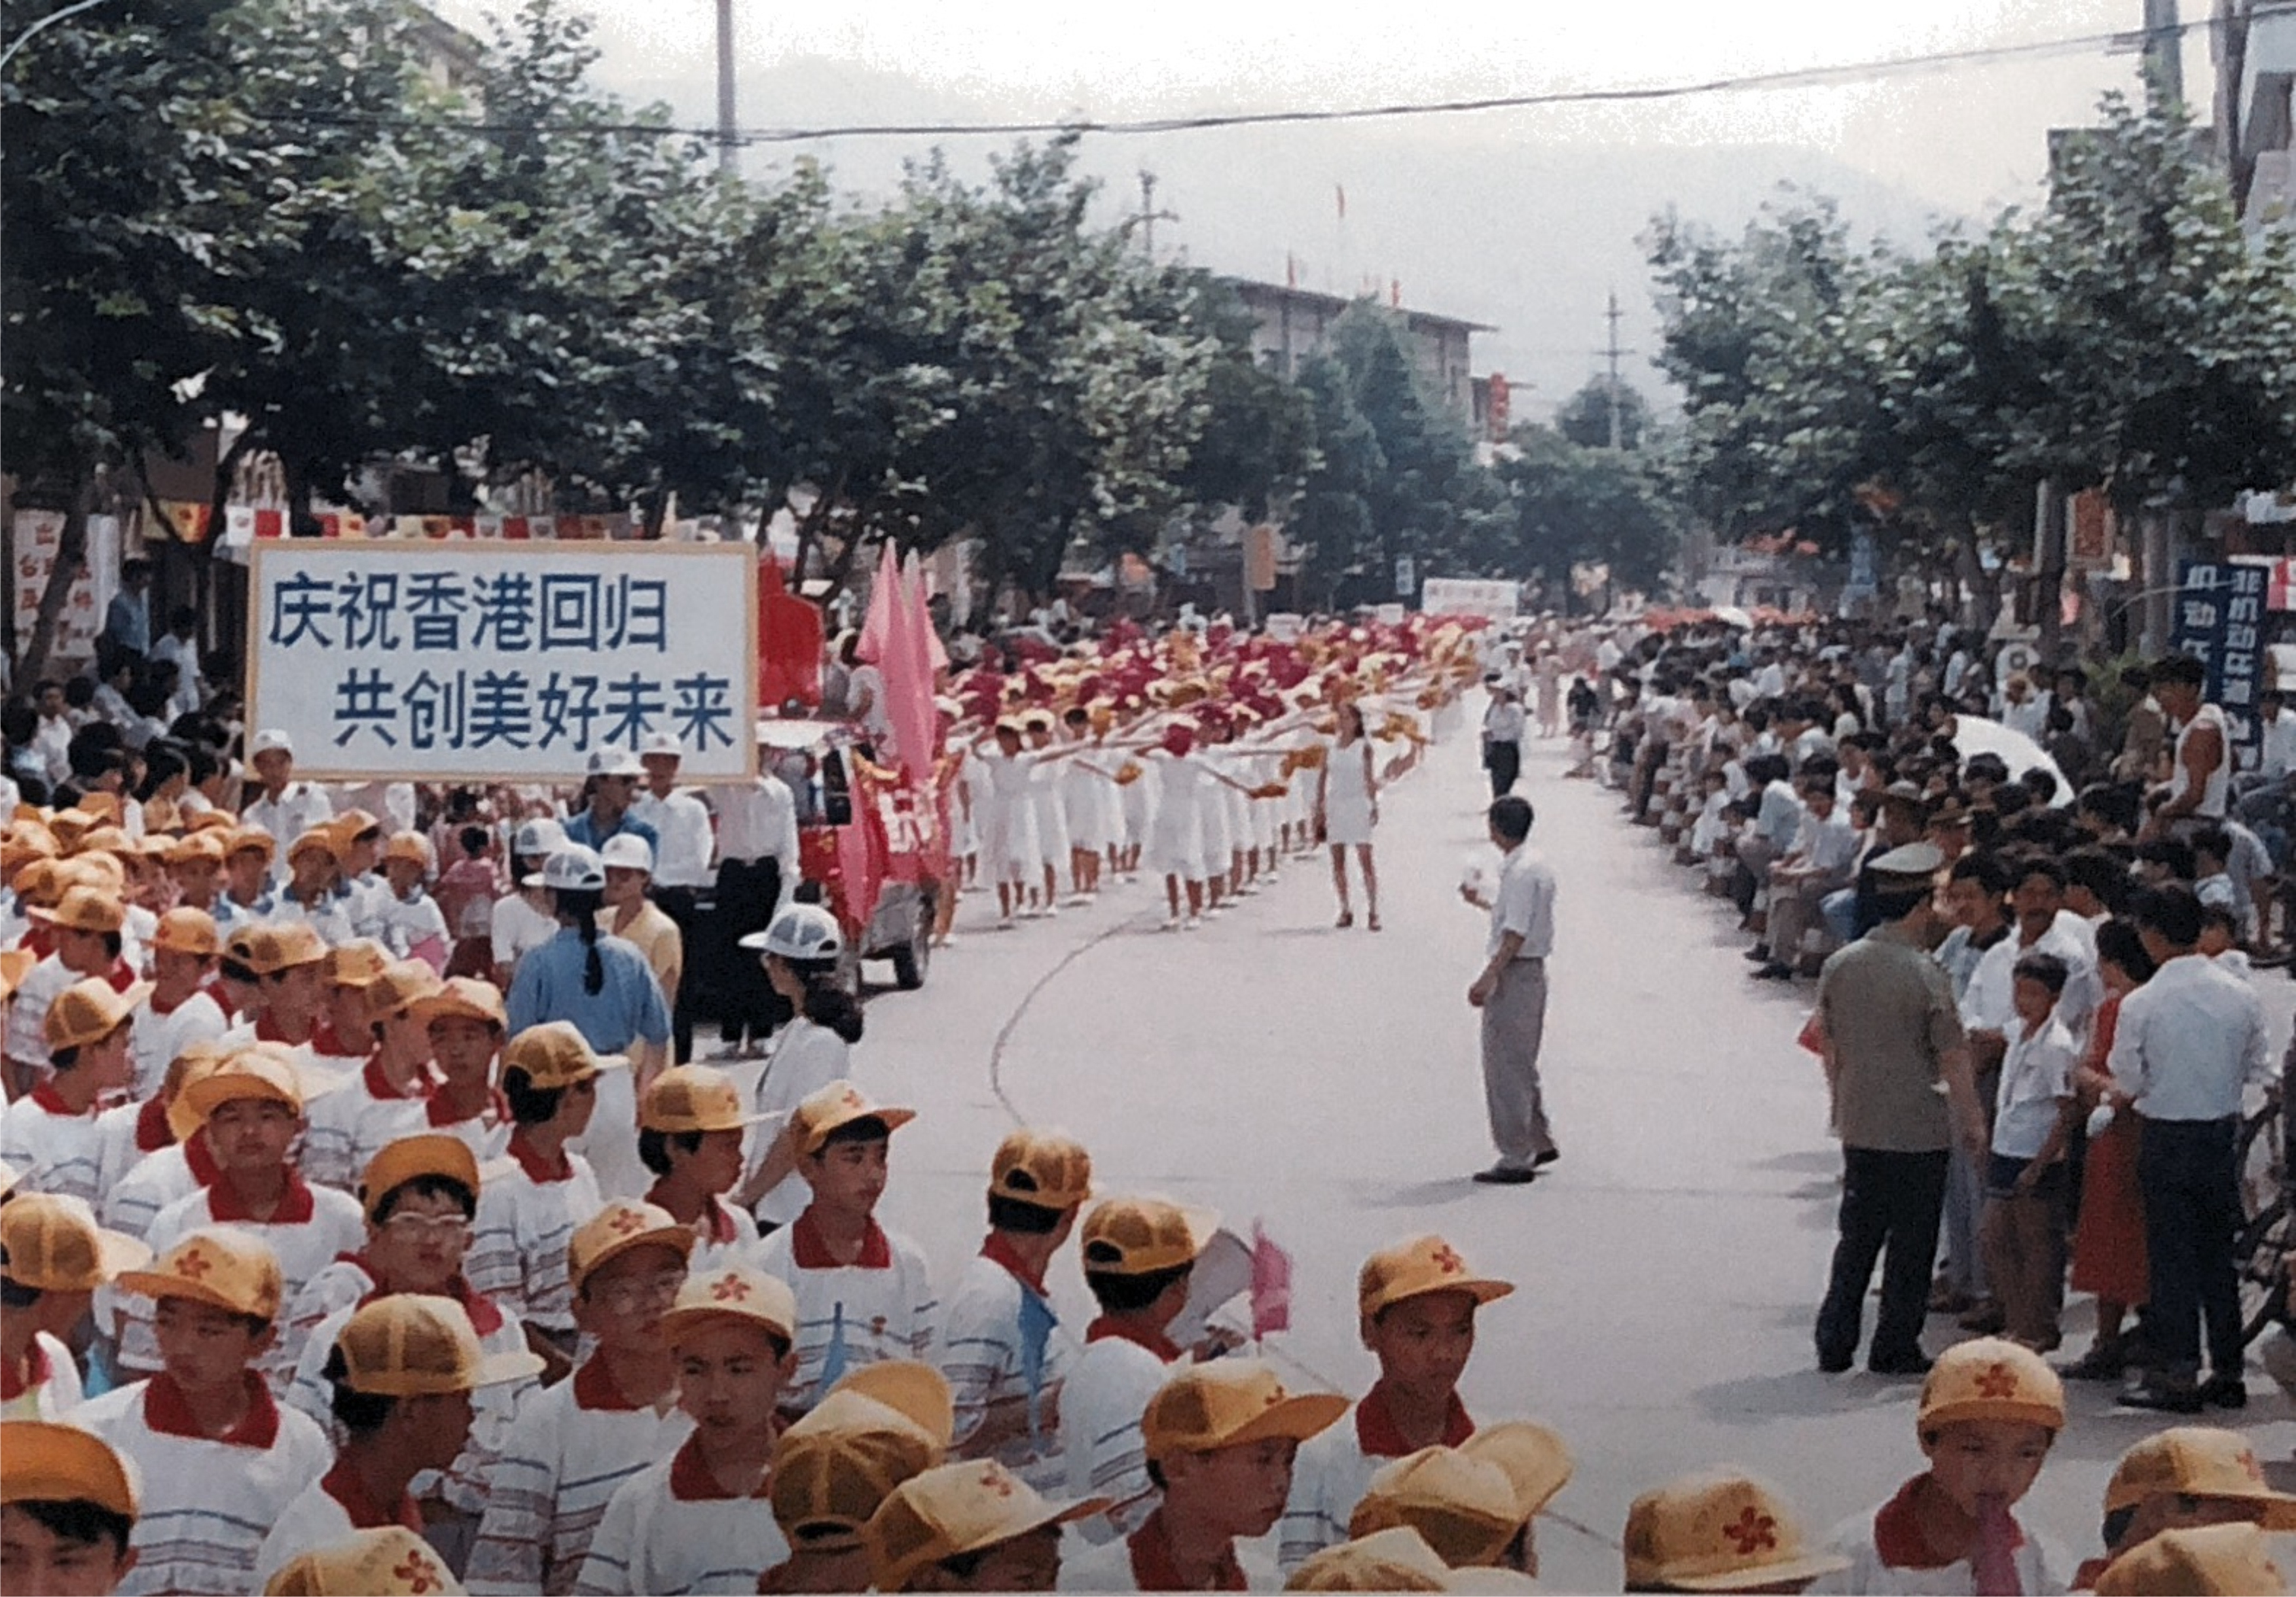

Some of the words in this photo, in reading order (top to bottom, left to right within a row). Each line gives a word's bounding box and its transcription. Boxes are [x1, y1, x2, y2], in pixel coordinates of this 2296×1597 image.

[269, 571, 666, 652] 庆祝香港回归
[333, 668, 735, 751] 共创美好未来
